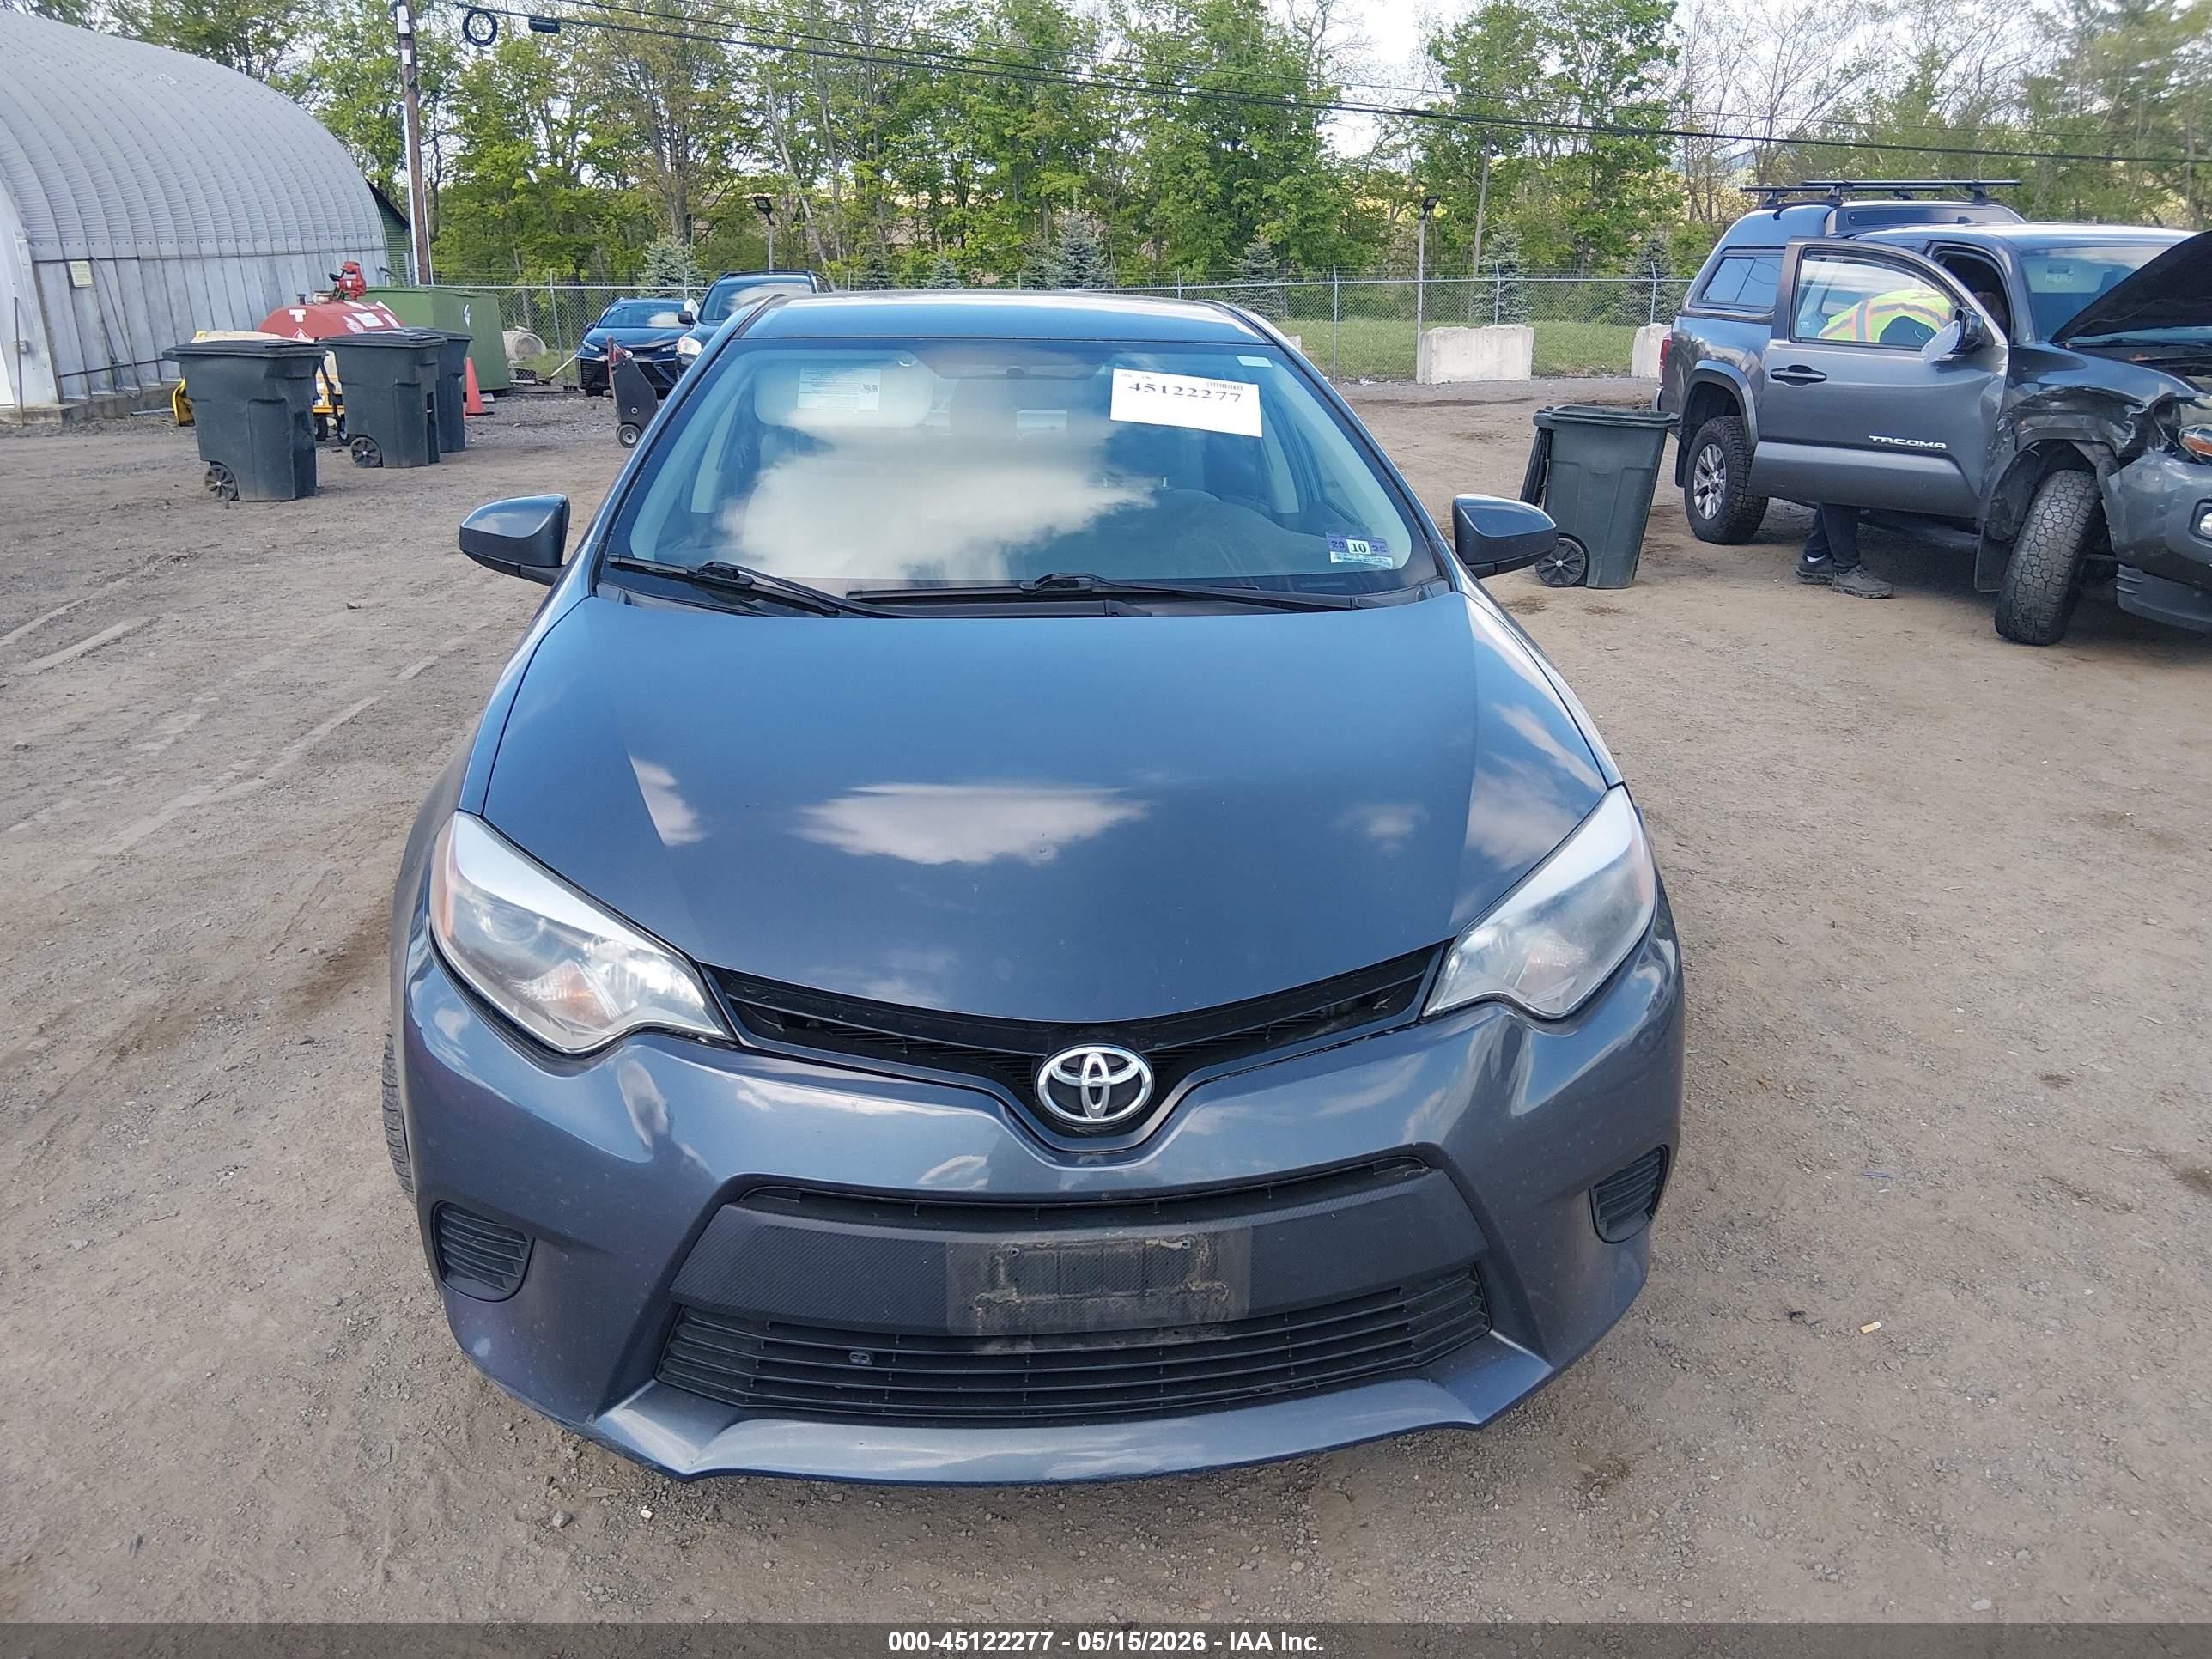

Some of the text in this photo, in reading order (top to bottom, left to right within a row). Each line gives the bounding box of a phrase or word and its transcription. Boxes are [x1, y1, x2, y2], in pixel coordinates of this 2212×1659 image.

[1128, 382, 1242, 403] 45122277
[1868, 434, 1947, 449] TACOMA
[1331, 540, 1345, 549] 20
[1351, 543, 1367, 553] 10
